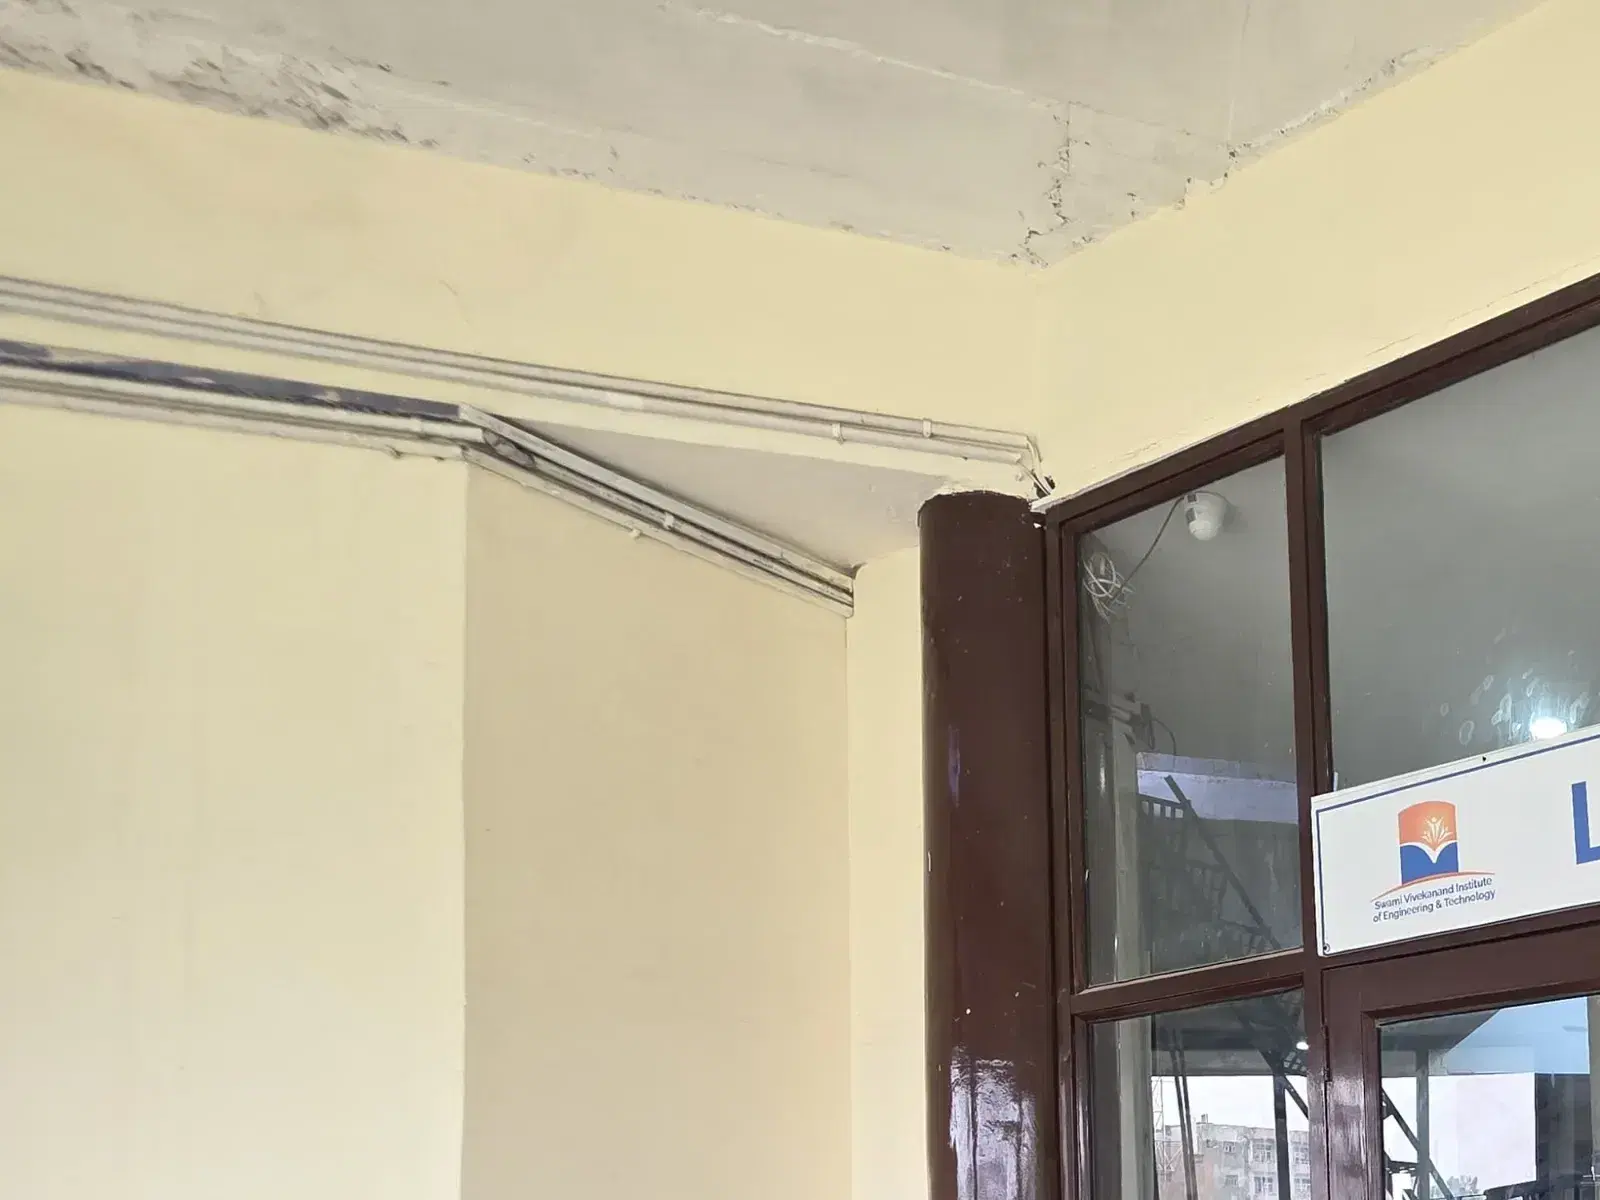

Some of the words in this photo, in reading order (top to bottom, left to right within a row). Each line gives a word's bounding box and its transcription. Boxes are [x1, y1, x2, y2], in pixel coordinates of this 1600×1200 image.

[1372, 913, 1382, 923] of
[1383, 902, 1434, 920] Engineering
[1435, 899, 1443, 909] &
[1443, 889, 1497, 907] Technology
[1374, 897, 1403, 910] Swami
[1404, 884, 1454, 903] Vivekanand
[1455, 877, 1493, 892] Institute
